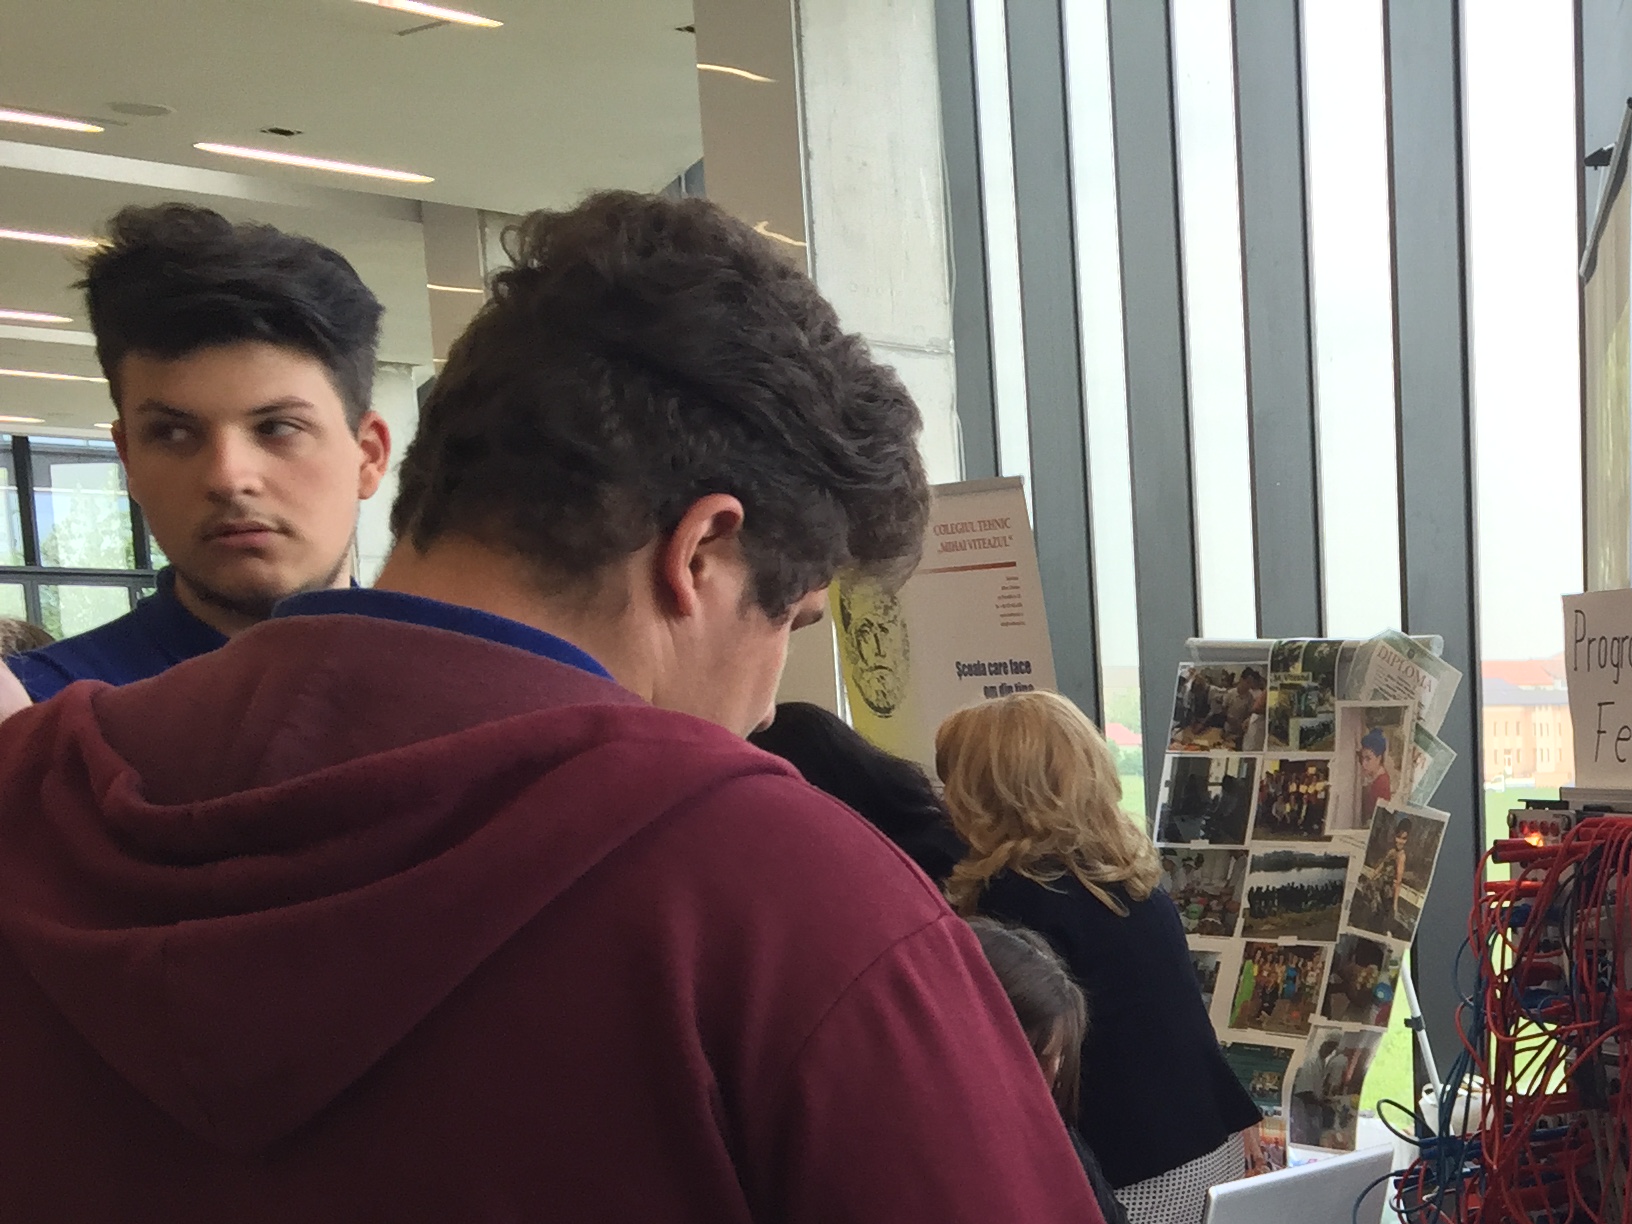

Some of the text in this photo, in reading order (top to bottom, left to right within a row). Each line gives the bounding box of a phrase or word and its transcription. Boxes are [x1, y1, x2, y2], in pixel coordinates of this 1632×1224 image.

[977, 517, 1011, 532] TEHNIC
[988, 661, 1009, 676] care
[1009, 659, 1032, 674] face
[1376, 646, 1433, 693] DIPLOMA
